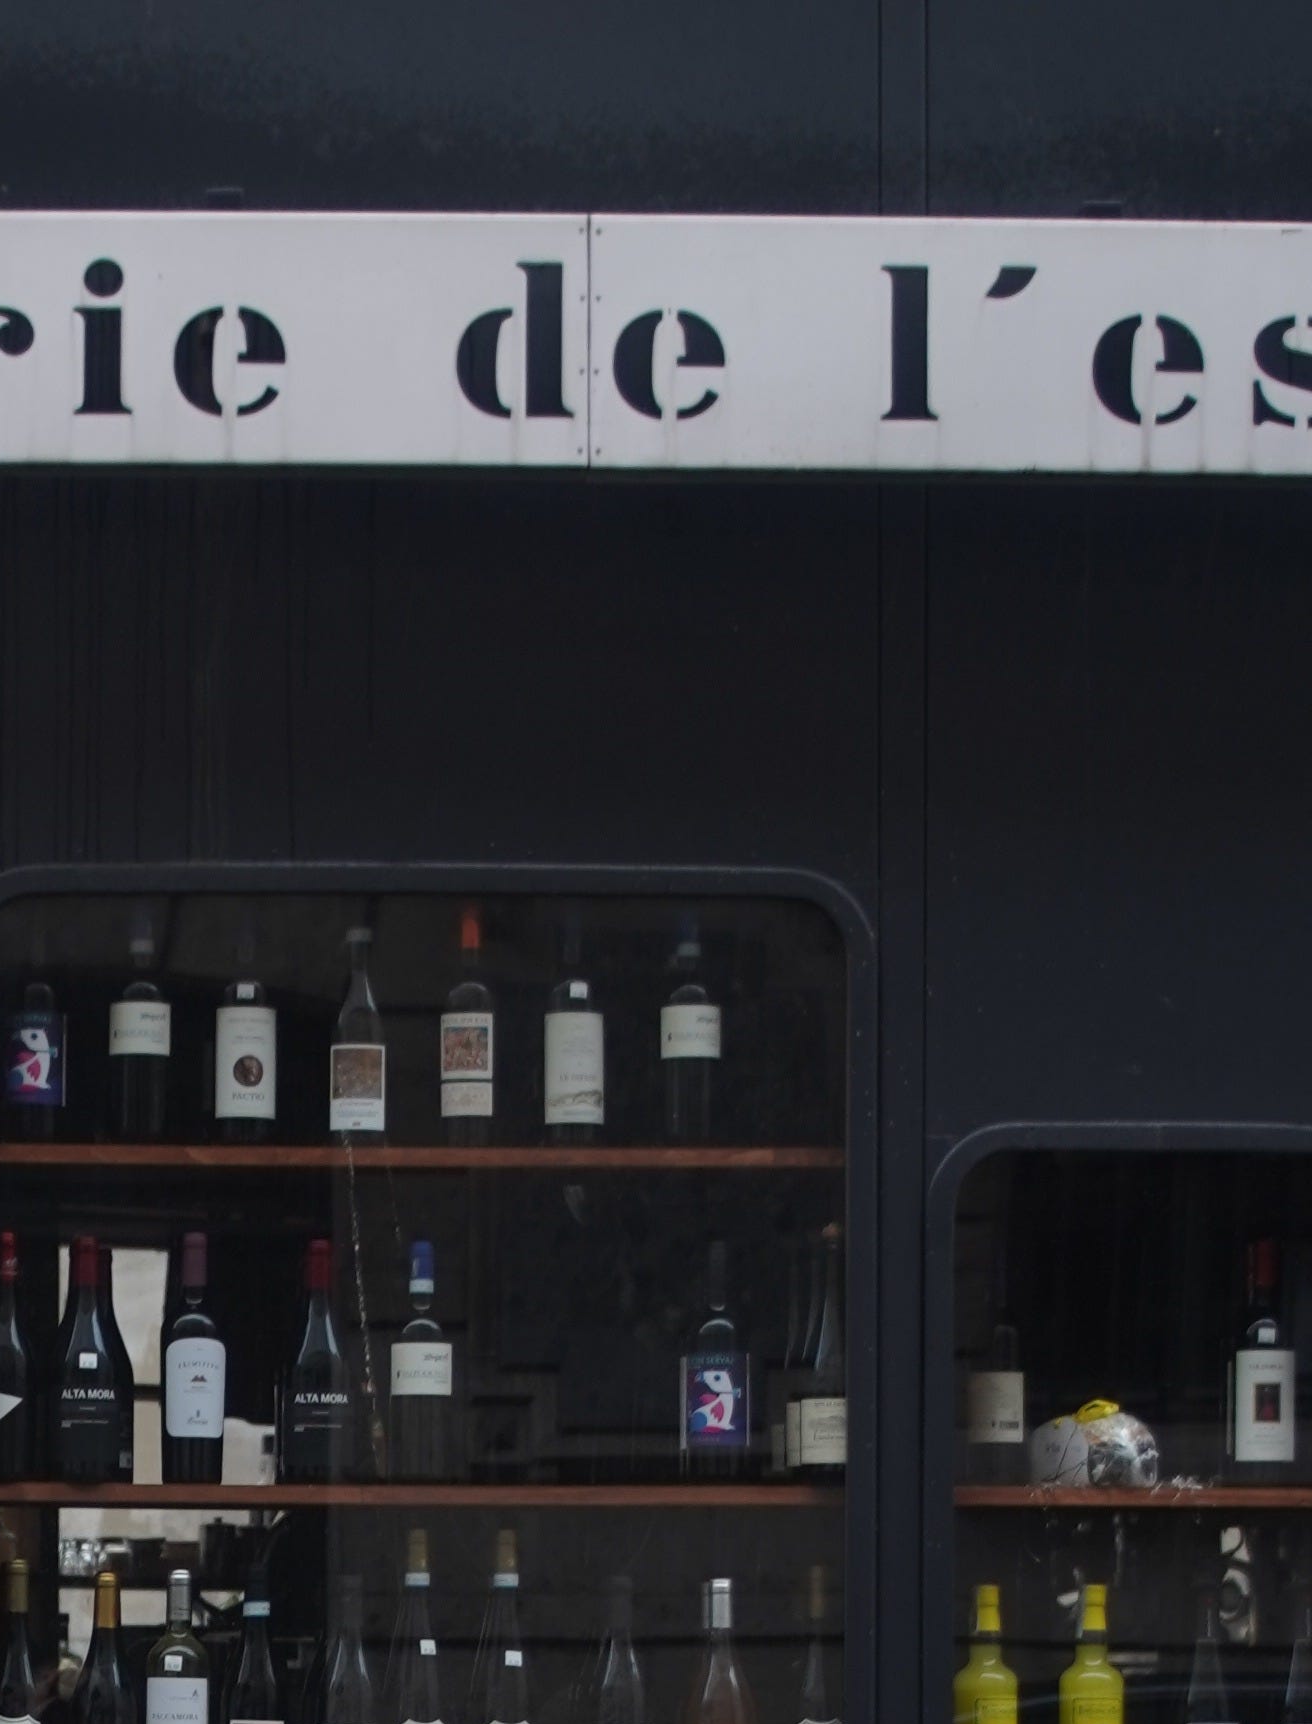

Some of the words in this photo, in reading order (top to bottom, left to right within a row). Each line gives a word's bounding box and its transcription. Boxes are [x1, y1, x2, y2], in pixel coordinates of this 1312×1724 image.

[456, 261, 726, 420] de
[61, 1388, 86, 1400] ALTA
[87, 1388, 115, 1400] MORA
[294, 1393, 319, 1404] ALTA
[320, 1393, 349, 1405] MORA
